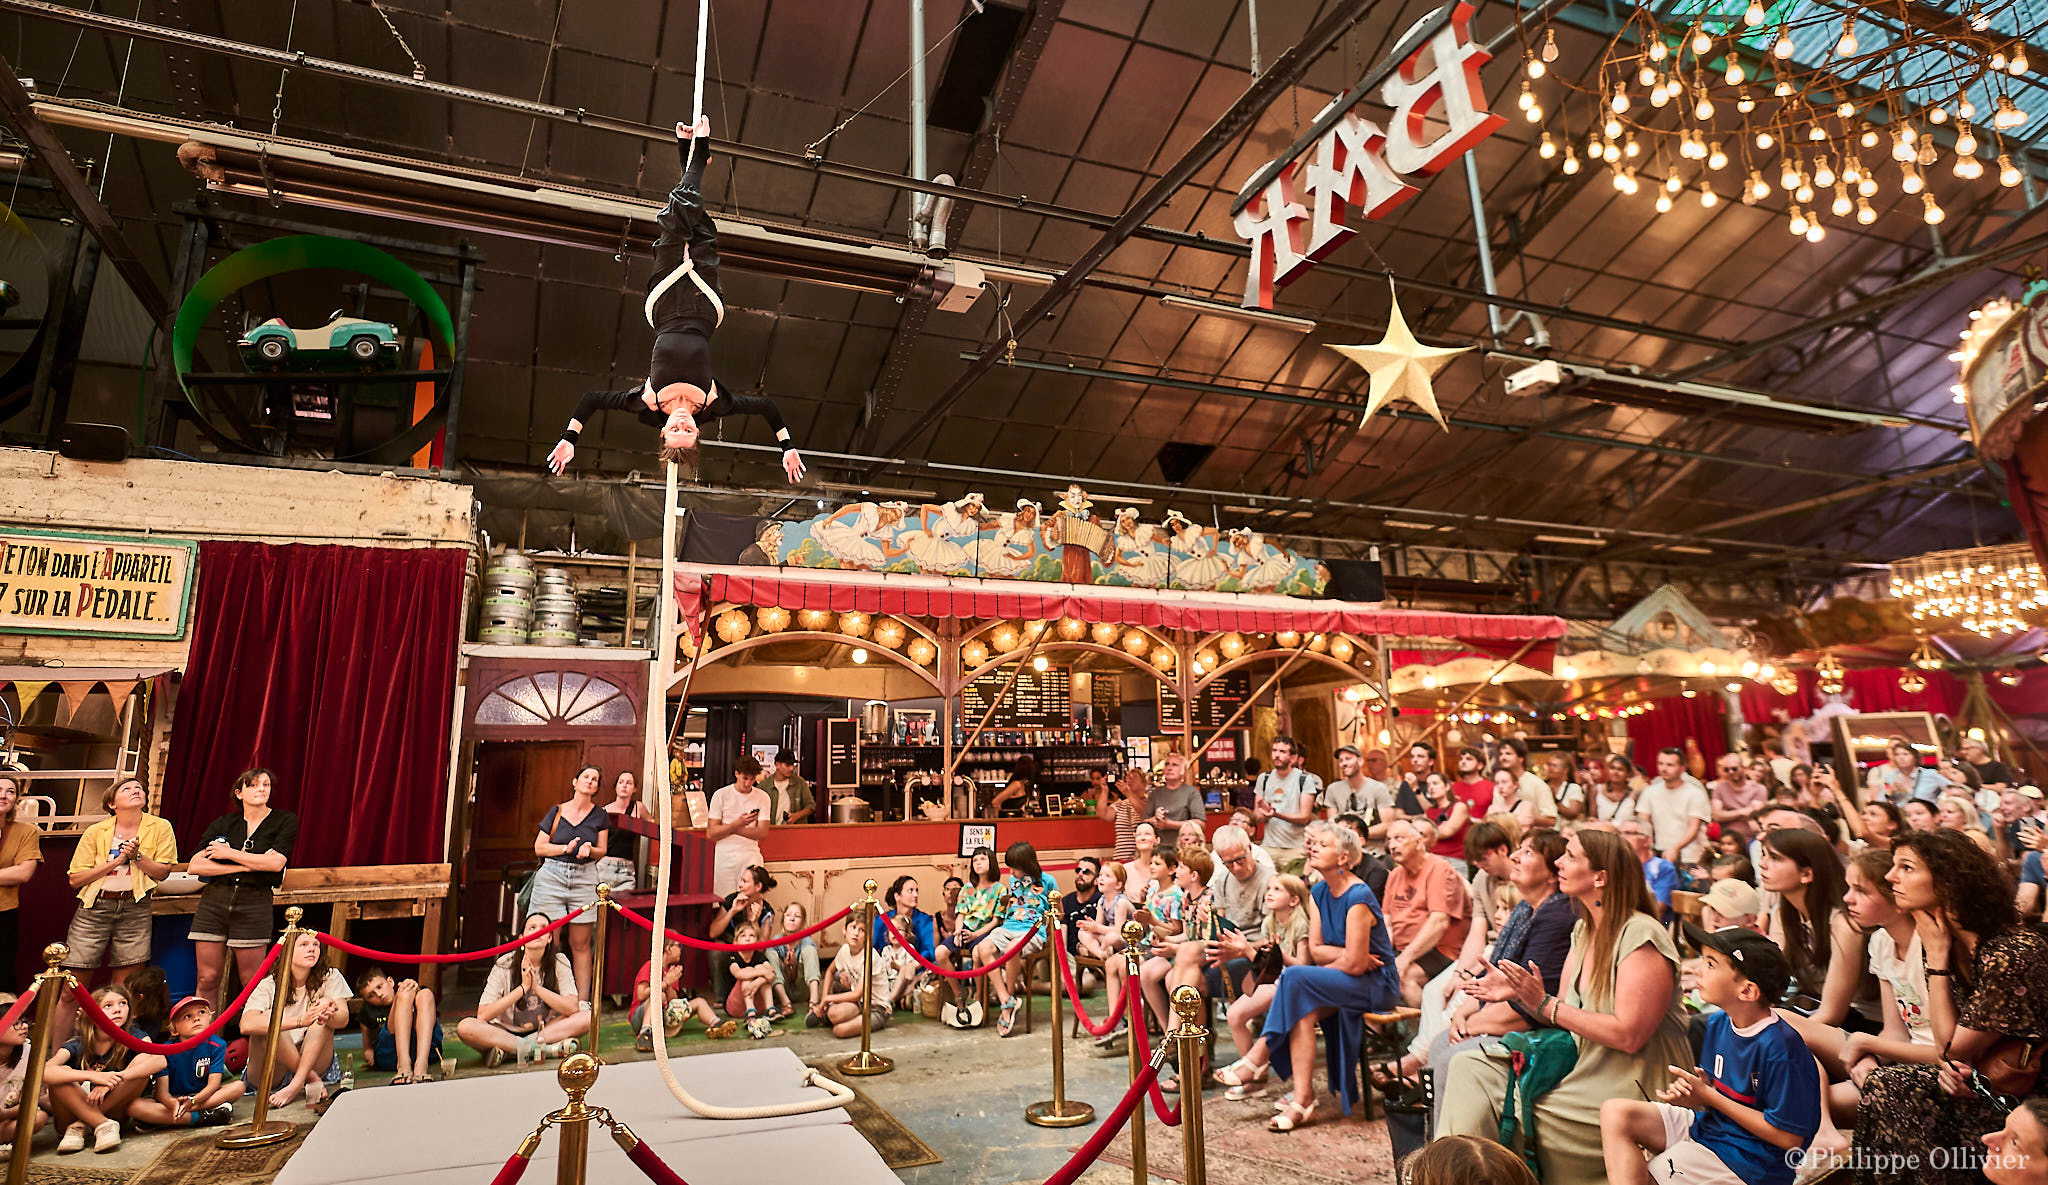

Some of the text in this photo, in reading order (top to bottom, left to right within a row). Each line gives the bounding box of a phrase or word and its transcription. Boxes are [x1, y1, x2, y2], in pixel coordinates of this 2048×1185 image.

[51, 553, 89, 579] DANS
[91, 548, 172, 584] L'APPAREIL
[11, 588, 48, 615] SUR
[52, 590, 72, 616] LA
[969, 828, 984, 836] SENS
[974, 837, 985, 845] FILE
